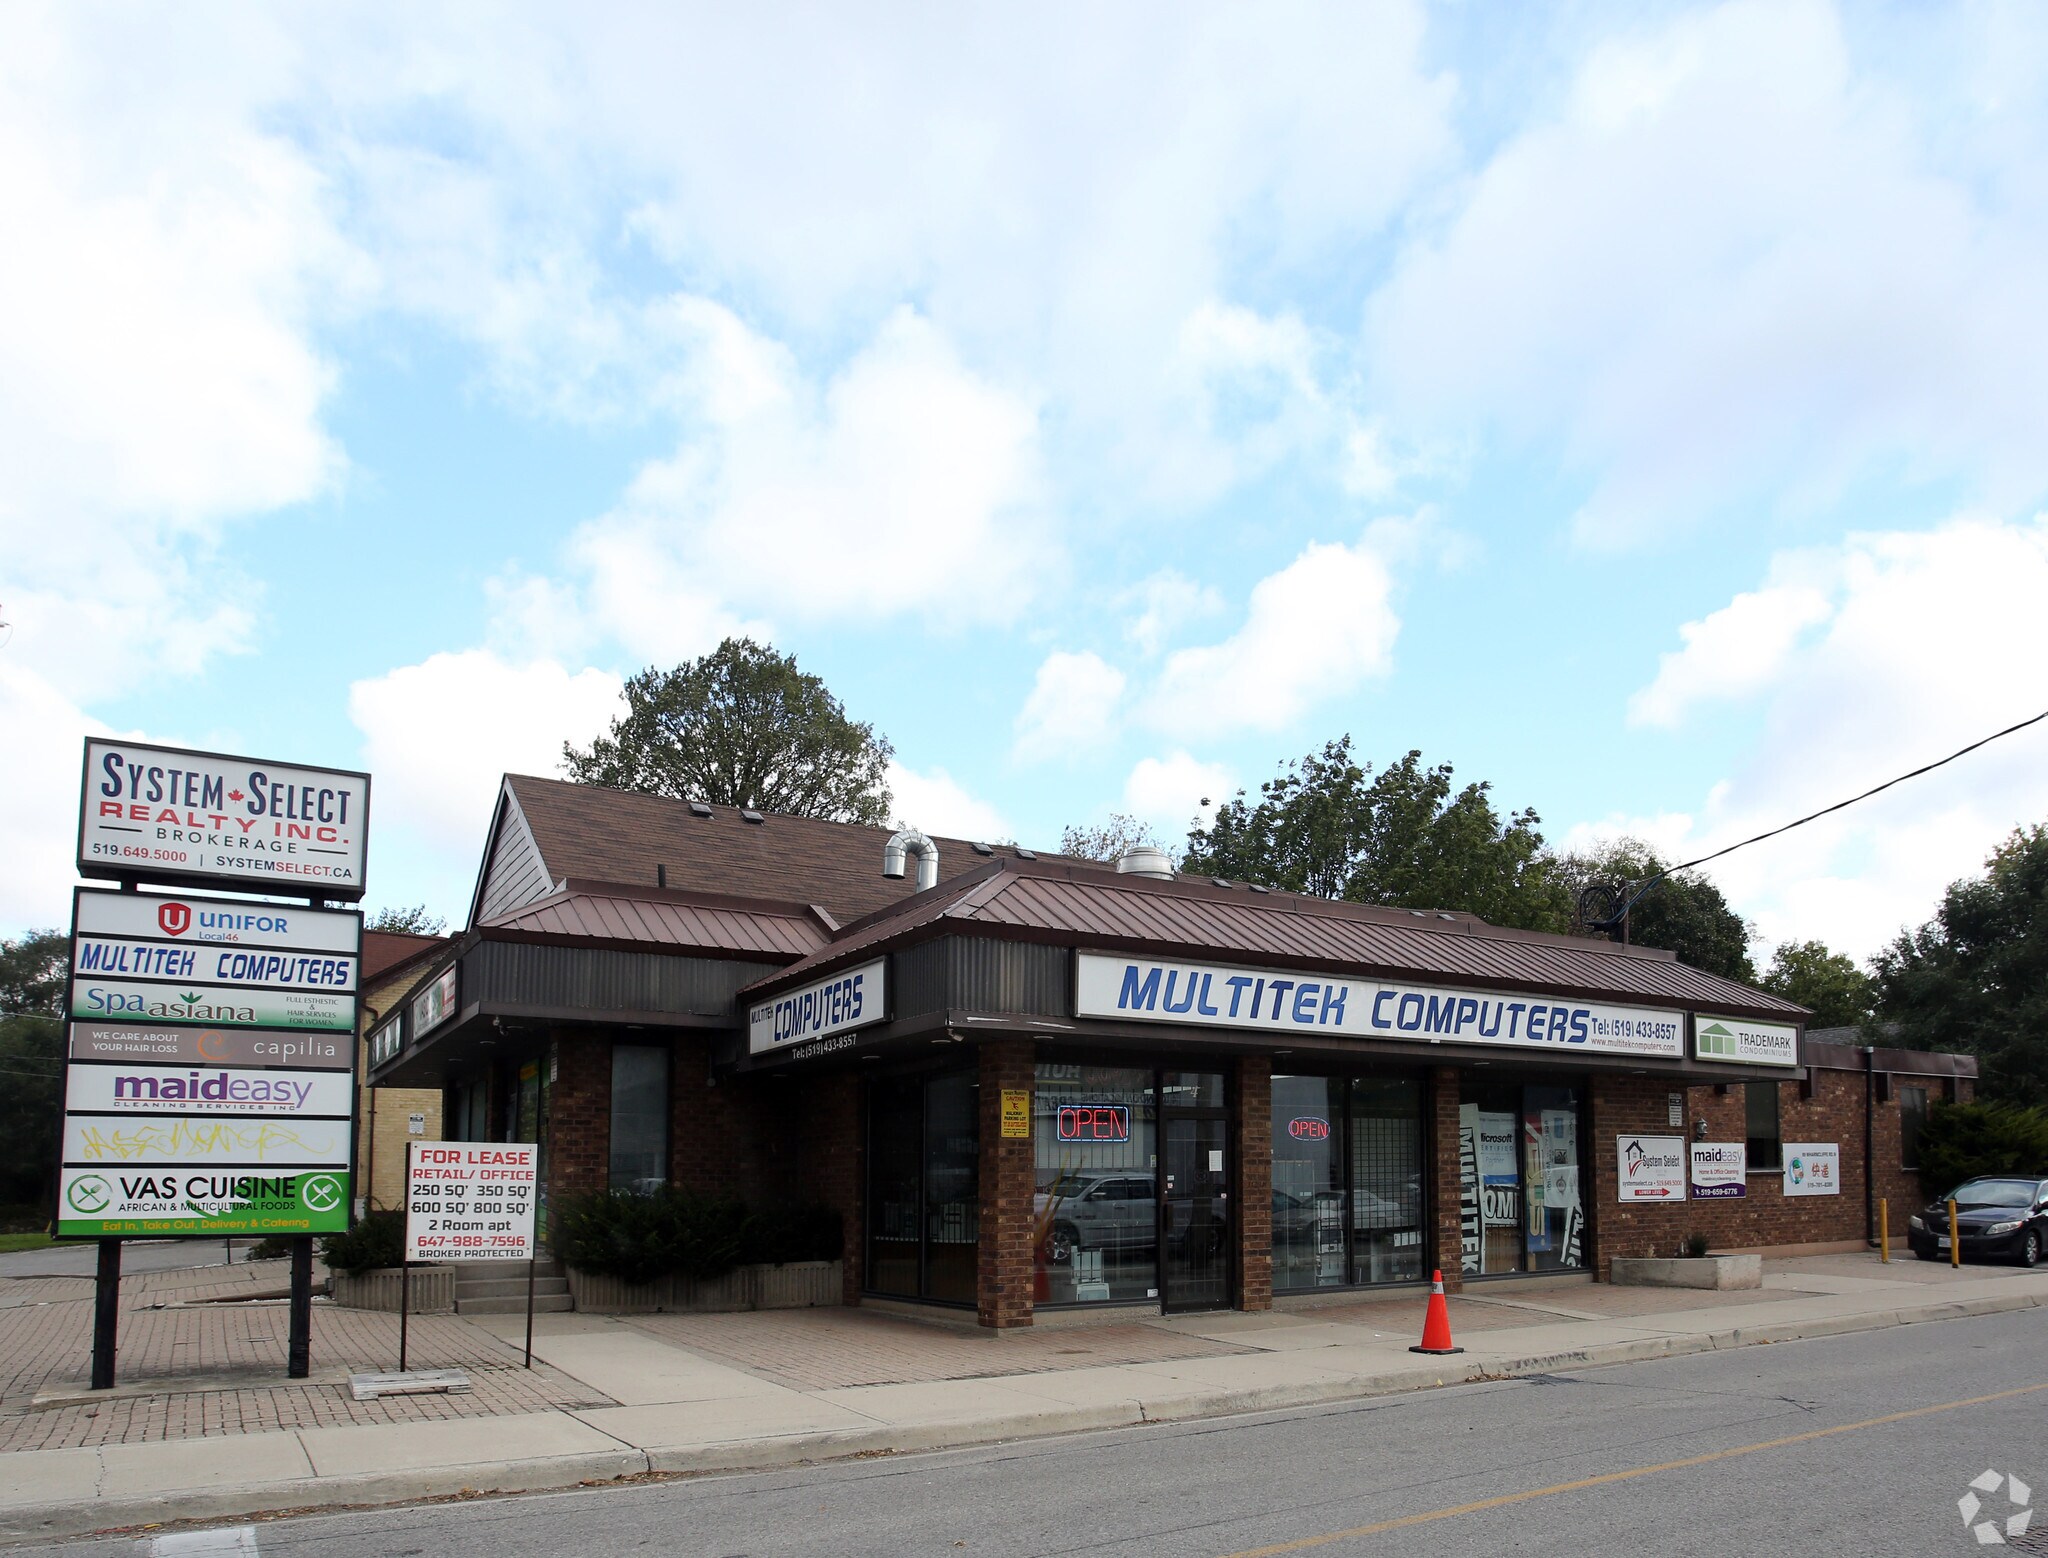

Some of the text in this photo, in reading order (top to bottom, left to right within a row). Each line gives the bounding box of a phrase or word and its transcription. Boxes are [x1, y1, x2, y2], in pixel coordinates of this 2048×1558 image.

[101, 753, 351, 825] SYSTEM SELECT
[100, 802, 349, 844] REALTY INC.
[156, 828, 297, 853] BROKERAGE
[93, 843, 352, 878] 519.649.5000 SYSTEMSELECT.CA
[80, 943, 350, 985] MULTITEK COMPUTERS
[87, 988, 257, 1022] Spa asiana
[774, 974, 863, 1041] COMPUTERS
[1117, 965, 1677, 1043] MULTITEK COMPUTERS Tel: (519) 433-8557
[92, 1031, 179, 1042] WE CARE ABOUT
[1739, 1033, 1791, 1049] TRADEMARK
[93, 1043, 178, 1053] YOUR HAIR LOSS
[254, 1037, 335, 1062] capilia
[1591, 1038, 1676, 1052] www.multitekcomputers.com
[1740, 1046, 1792, 1057] CONDOMINIUMS
[114, 1072, 313, 1108] maideasy
[1060, 1109, 1127, 1138] OPEN
[1289, 1120, 1328, 1137] OPEN
[420, 1150, 530, 1165] FOR LEASE
[1643, 1154, 1680, 1169] System Select
[1694, 1148, 1742, 1164] maideasy
[412, 1169, 535, 1181] RETAIL/ OFFICE
[119, 1176, 296, 1200] VAS CUISINE
[412, 1185, 440, 1196] 250
[476, 1186, 503, 1197] 350
[1700, 1188, 1738, 1196] 519-659-6776
[118, 1201, 296, 1212] AFRICAN & MULTICULTURAL FOODS
[412, 1202, 441, 1213] 600
[473, 1203, 501, 1213] 800
[103, 1218, 310, 1231] Eat In, Take Out, Delivery & Catering
[428, 1220, 512, 1233] 2 Room apt
[417, 1235, 525, 1247] 647-988-7596
[419, 1250, 523, 1258] BROKER PROTECTED
